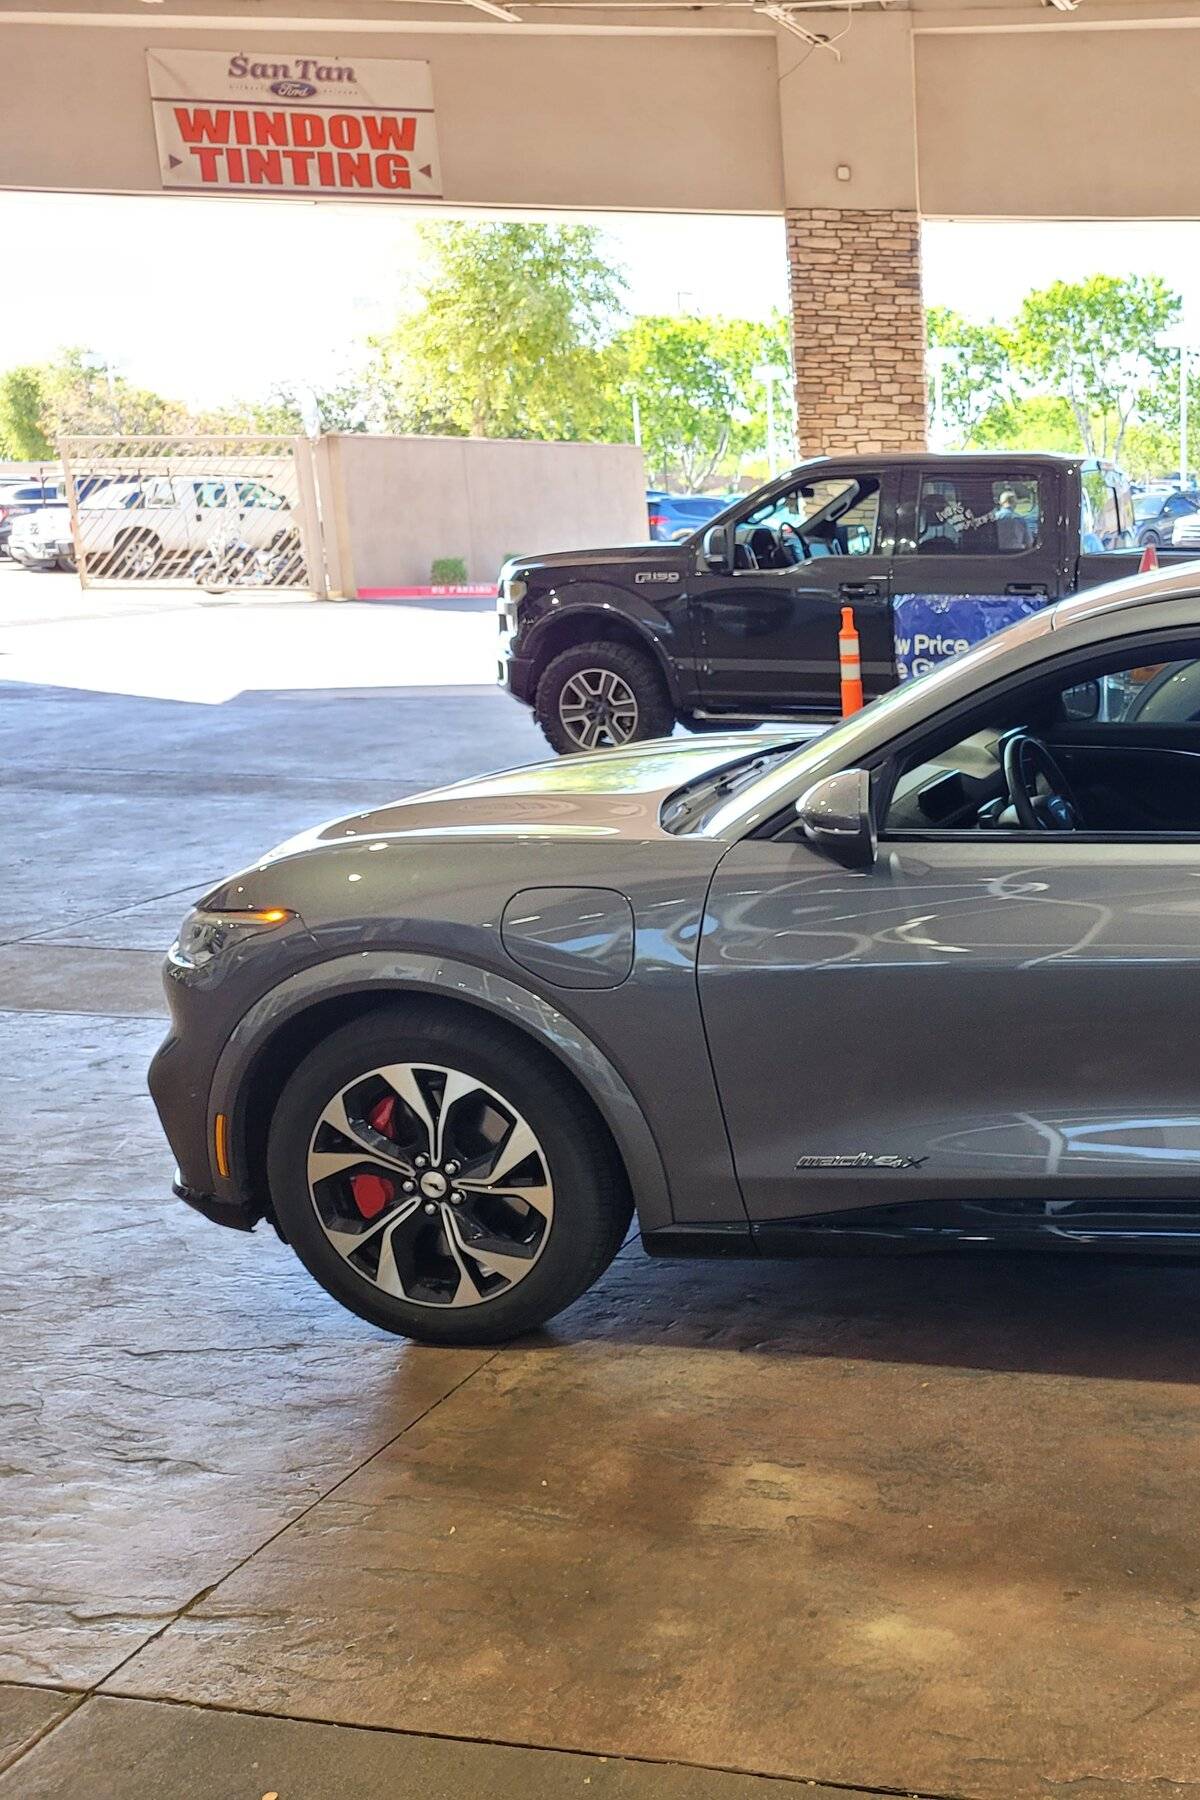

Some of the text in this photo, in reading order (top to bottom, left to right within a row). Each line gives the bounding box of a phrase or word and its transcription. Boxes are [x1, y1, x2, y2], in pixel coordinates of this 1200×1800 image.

[228, 55, 358, 83] San Tan
[275, 82, 311, 97] Ford
[173, 107, 417, 152] WINDOW
[189, 146, 412, 190] TINTING
[914, 633, 970, 656] Price
